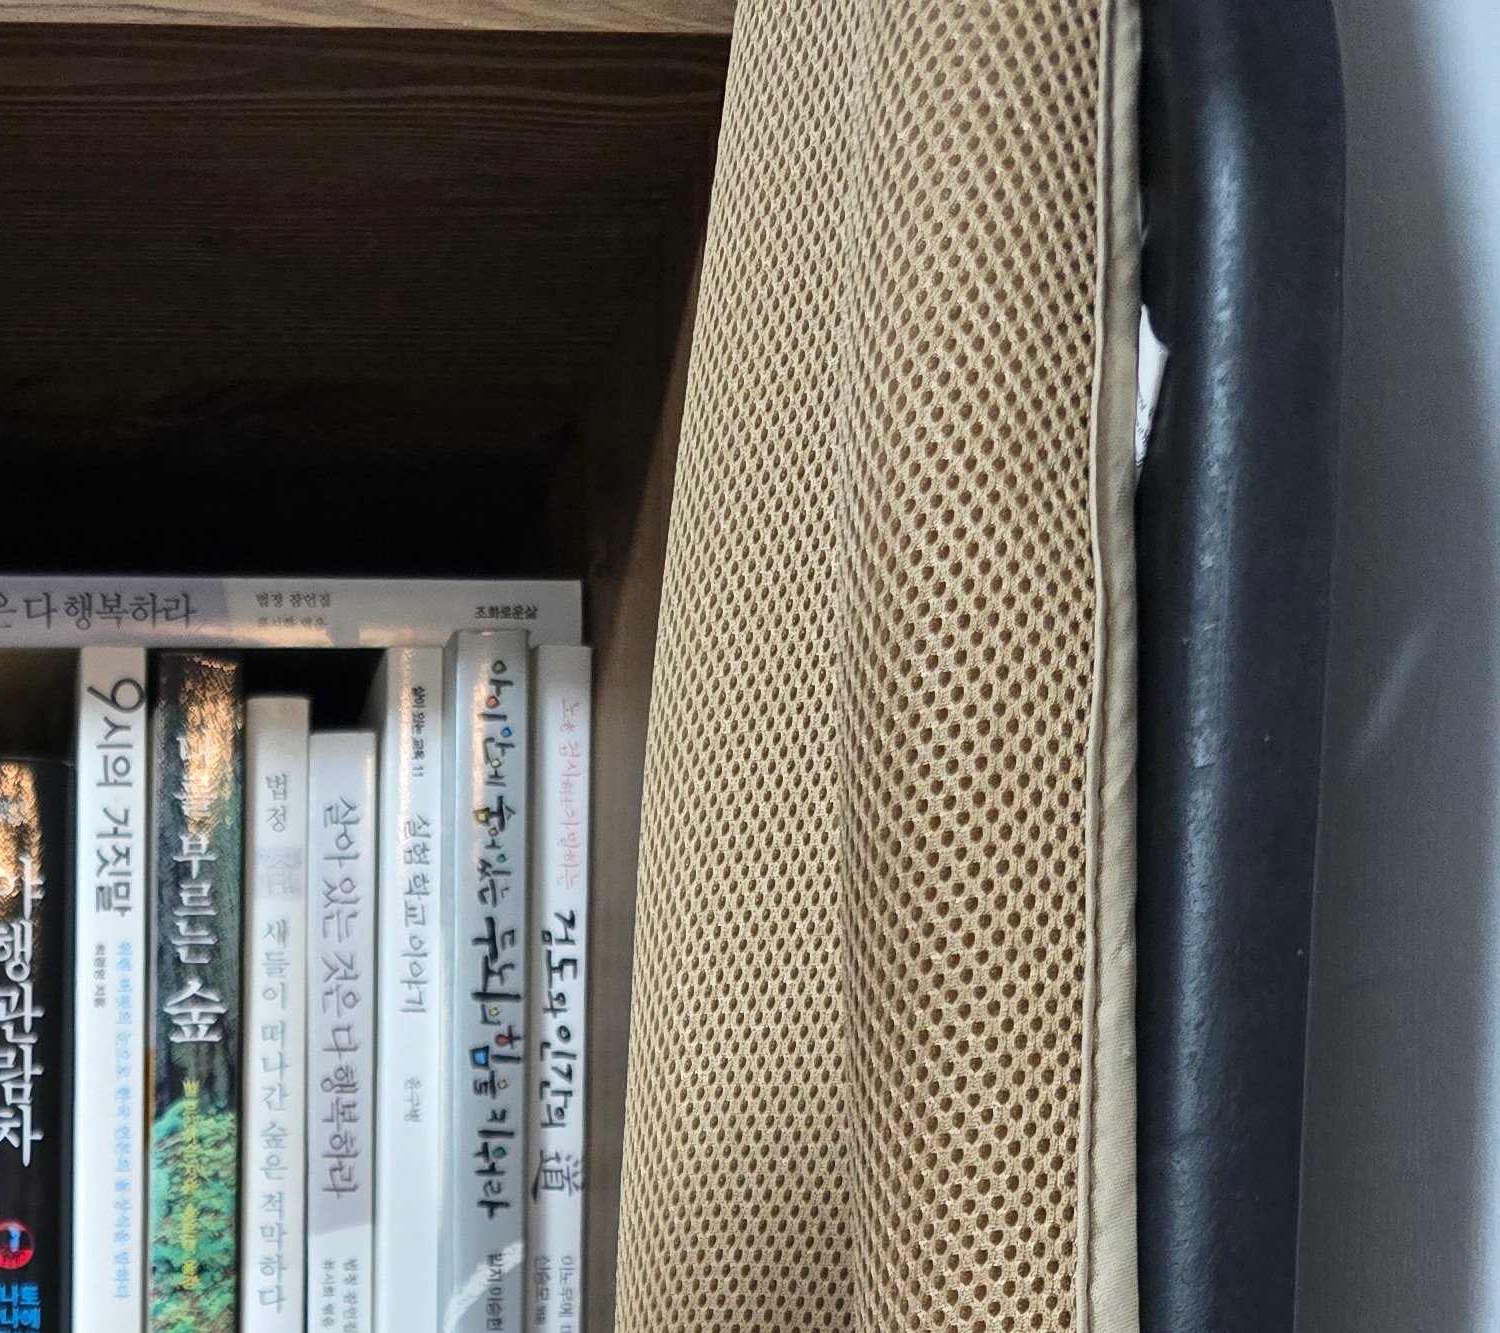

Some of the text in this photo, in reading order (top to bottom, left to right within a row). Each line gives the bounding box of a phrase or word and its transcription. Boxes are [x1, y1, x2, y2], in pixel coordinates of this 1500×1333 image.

[23, 590, 58, 631] 다
[63, 588, 198, 633] 행복하라
[87, 677, 146, 917] 9시의 거짓말
[265, 774, 288, 833] 법정
[168, 834, 219, 965] 부르는
[399, 813, 431, 1015] 실험 학교 이야기
[162, 976, 229, 1044] 숲
[320, 797, 361, 1200] 살아 있는 것은 다 행복하라
[538, 910, 578, 1130] 검도와 인간의
[258, 919, 291, 1315] 새들이 떠나간 적막하다
[473, 1108, 516, 1220] 키워라
[557, 1255, 574, 1318] 이노우에
